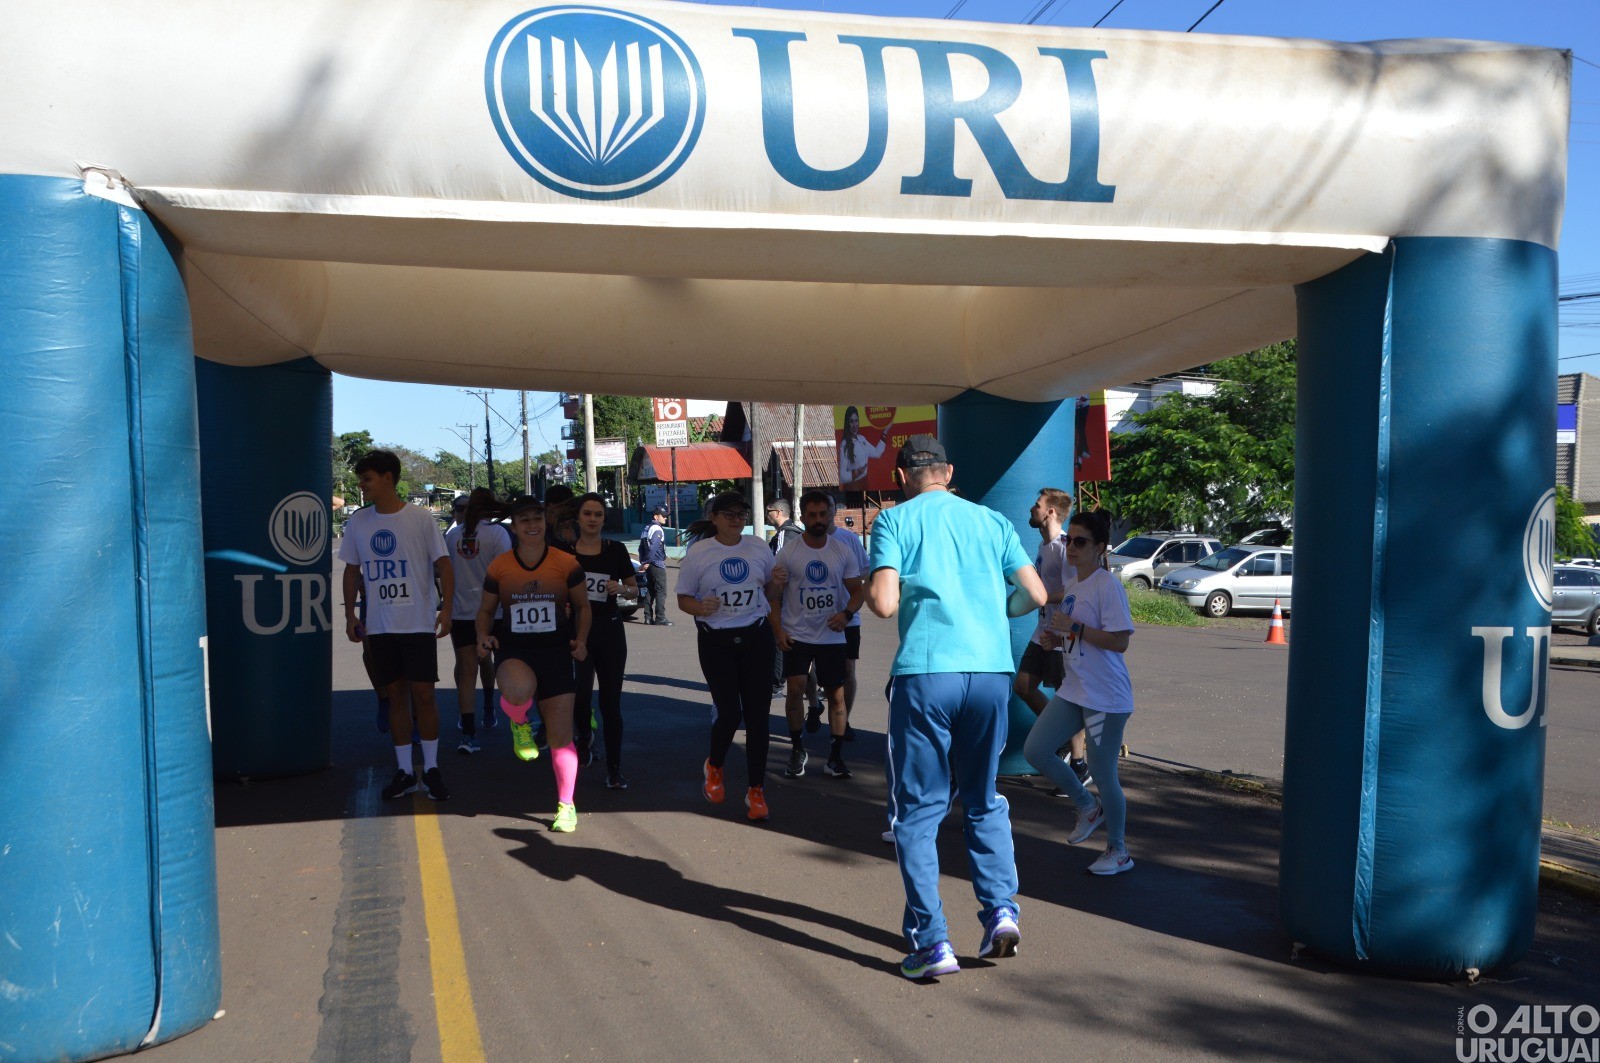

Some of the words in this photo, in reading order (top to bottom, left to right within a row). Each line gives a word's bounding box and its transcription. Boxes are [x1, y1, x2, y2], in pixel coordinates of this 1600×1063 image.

[731, 27, 1117, 204] URI
[657, 402, 682, 420] 10
[656, 422, 685, 430] RESTAURANTE
[364, 559, 408, 582] URI
[379, 582, 410, 600] 001
[586, 577, 606, 594] 26
[234, 573, 332, 636] UR
[720, 589, 754, 607] 127
[806, 593, 834, 610] 068
[516, 606, 552, 625] 101
